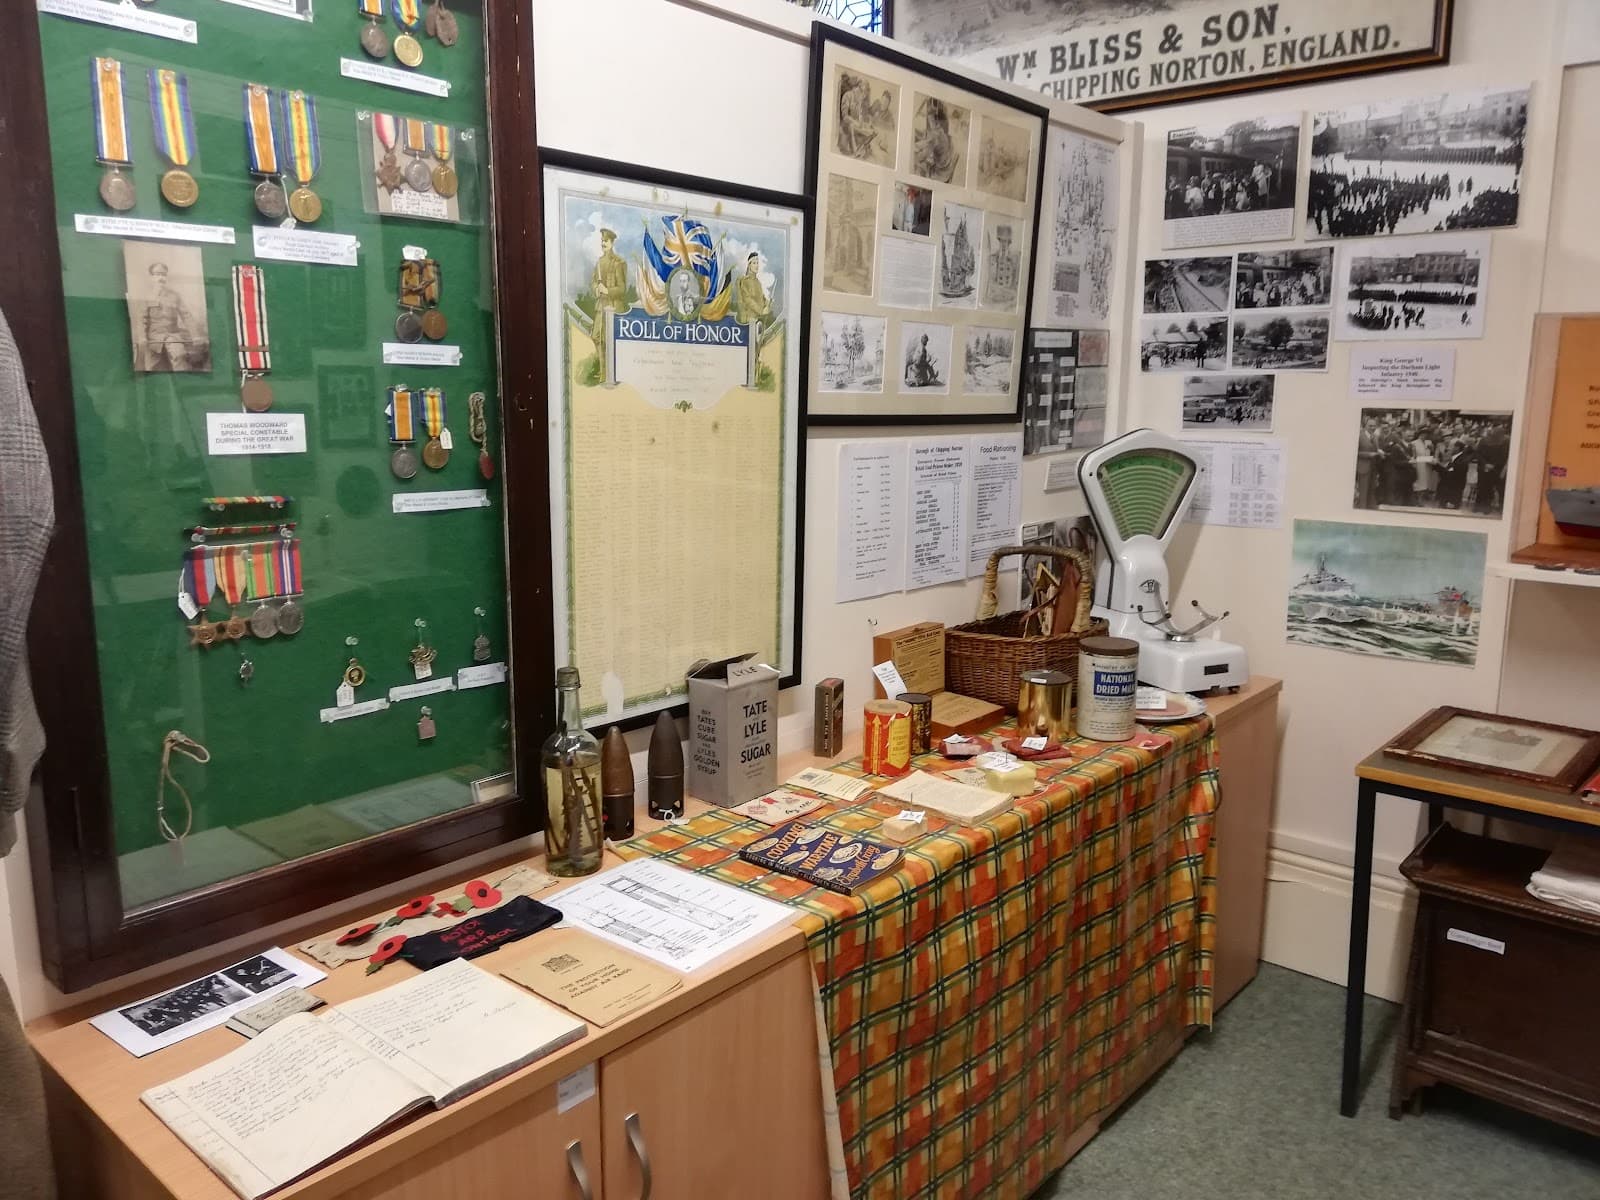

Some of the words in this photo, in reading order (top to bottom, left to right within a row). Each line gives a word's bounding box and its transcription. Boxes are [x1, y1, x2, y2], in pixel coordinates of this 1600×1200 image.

[1050, 30, 1142, 75] BLISS
[1159, 24, 1183, 54] &
[1040, 67, 1140, 100] CHIPPING
[1262, 24, 1400, 69] ENGLAND.
[619, 318, 660, 339] ROLL
[663, 325, 682, 340] OF
[685, 323, 743, 343] HONOR
[993, 445, 1017, 453] Rationing
[732, 666, 758, 677] LYLE
[1101, 673, 1135, 683] NATIONAL
[1096, 684, 1120, 694] DRIED
[743, 700, 767, 718] TATE
[697, 724, 715, 734] CUBE
[744, 719, 767, 738] LYLE
[697, 732, 716, 744] SUGAR
[693, 754, 720, 768] GOLDEN
[740, 743, 771, 763] SUGAR
[697, 764, 717, 775] SYRUP
[766, 822, 806, 860] COOKING
[745, 853, 767, 865] COOKING
[799, 833, 839, 871] WARTIME
[857, 845, 880, 863] Craig
[560, 983, 573, 991] THE
[575, 963, 617, 983] PROTECTION
[570, 983, 599, 998] AGAINST
[600, 978, 611, 986] AIR
[613, 968, 632, 979] RAIDS
[580, 977, 598, 988] YOUR
[599, 968, 620, 979] HOME
